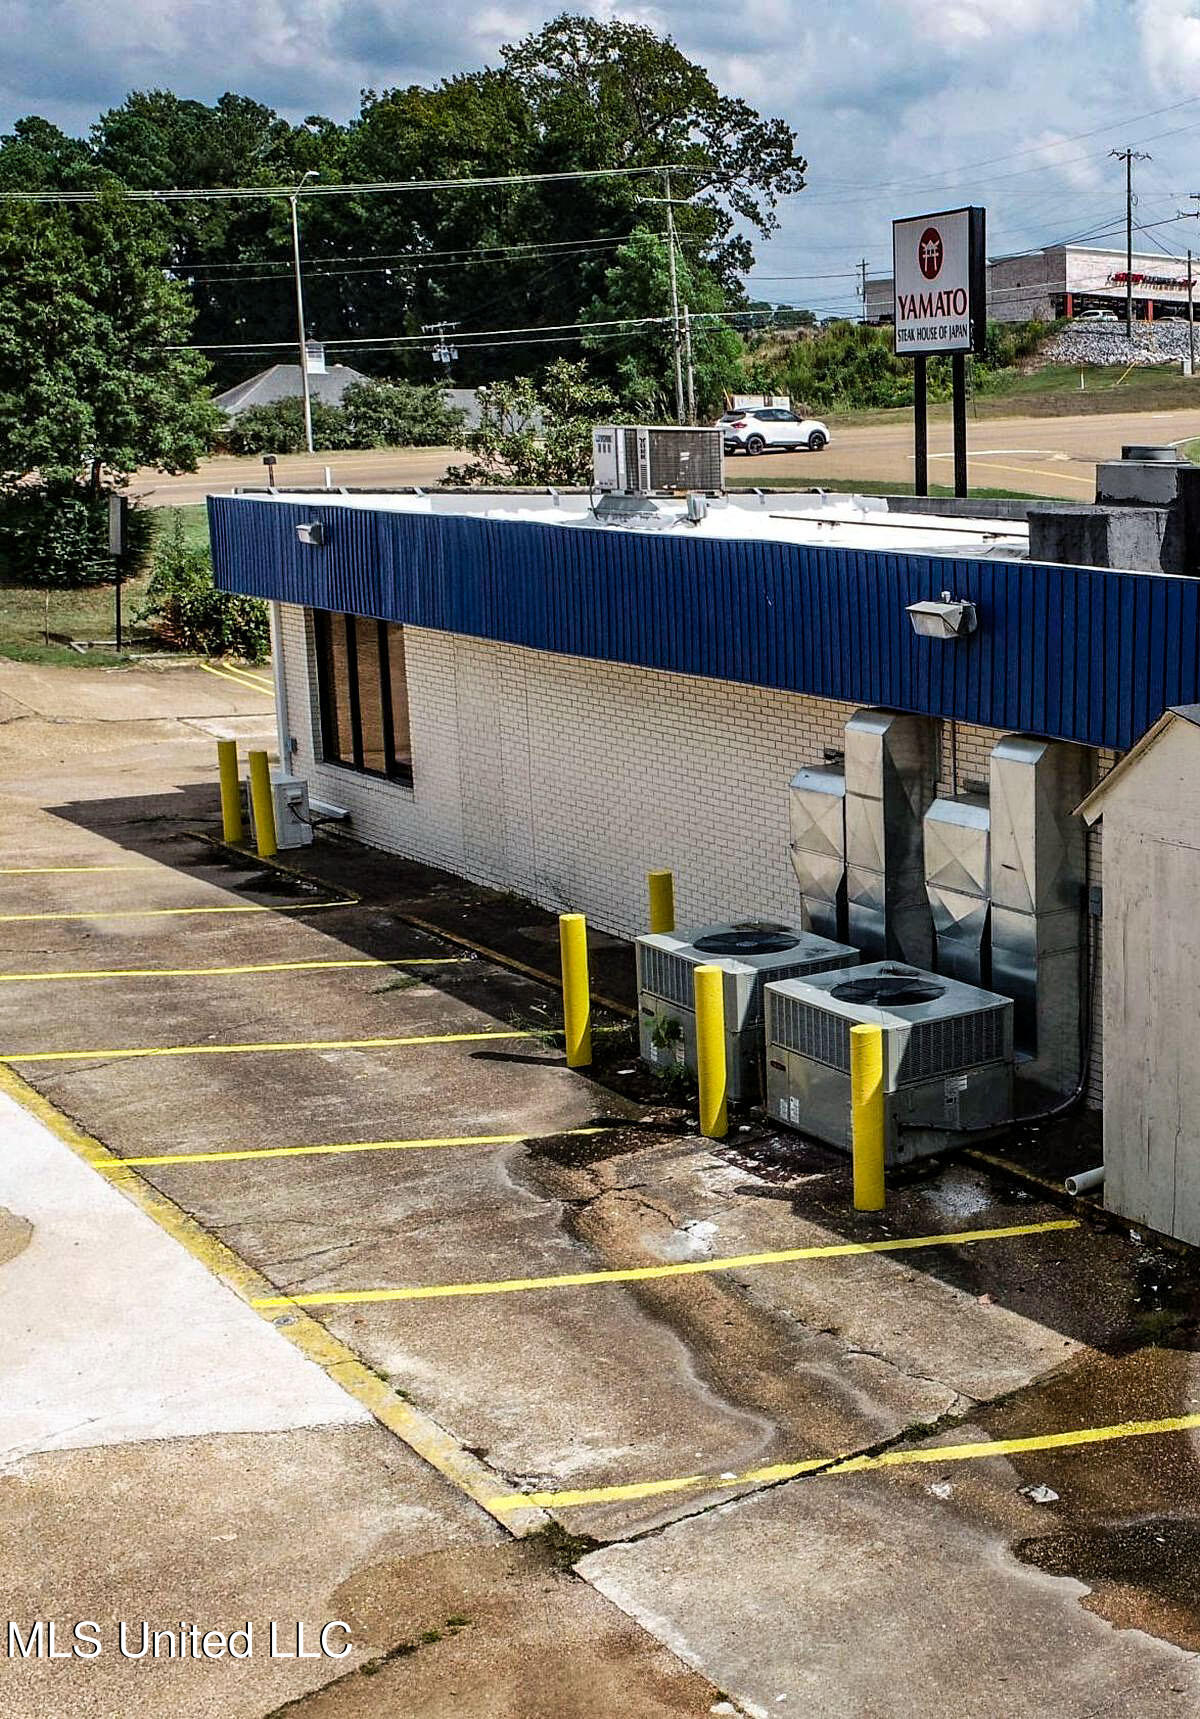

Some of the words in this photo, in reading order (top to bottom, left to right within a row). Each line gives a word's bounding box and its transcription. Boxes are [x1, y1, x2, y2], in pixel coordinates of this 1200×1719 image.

[898, 288, 968, 320] YAMATO
[898, 328, 915, 342] STEAK
[917, 326, 938, 341] HOUSE
[939, 325, 948, 340] OF
[949, 323, 968, 341] JAPAN
